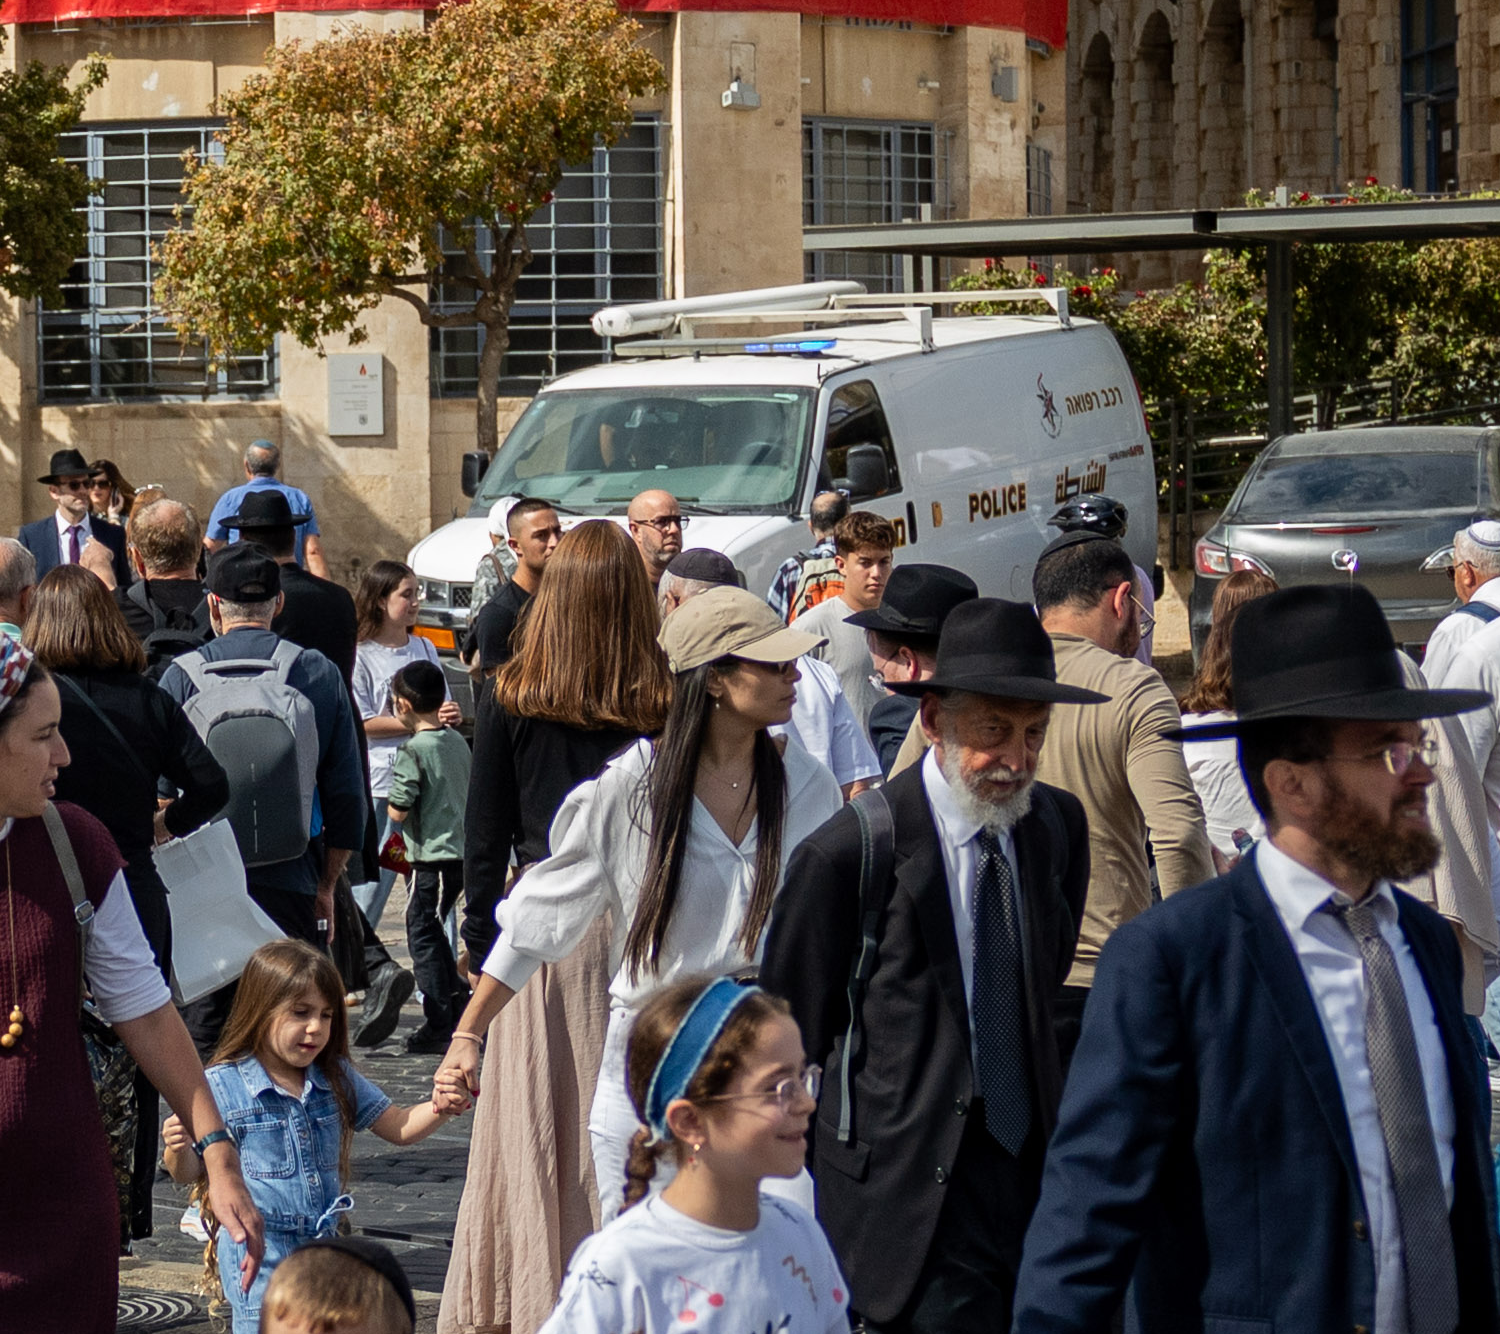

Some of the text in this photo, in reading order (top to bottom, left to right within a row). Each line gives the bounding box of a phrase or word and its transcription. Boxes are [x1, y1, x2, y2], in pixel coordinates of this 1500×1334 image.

[1065, 387, 1123, 416] רכב רפואה
[969, 482, 1026, 523] POLICE
